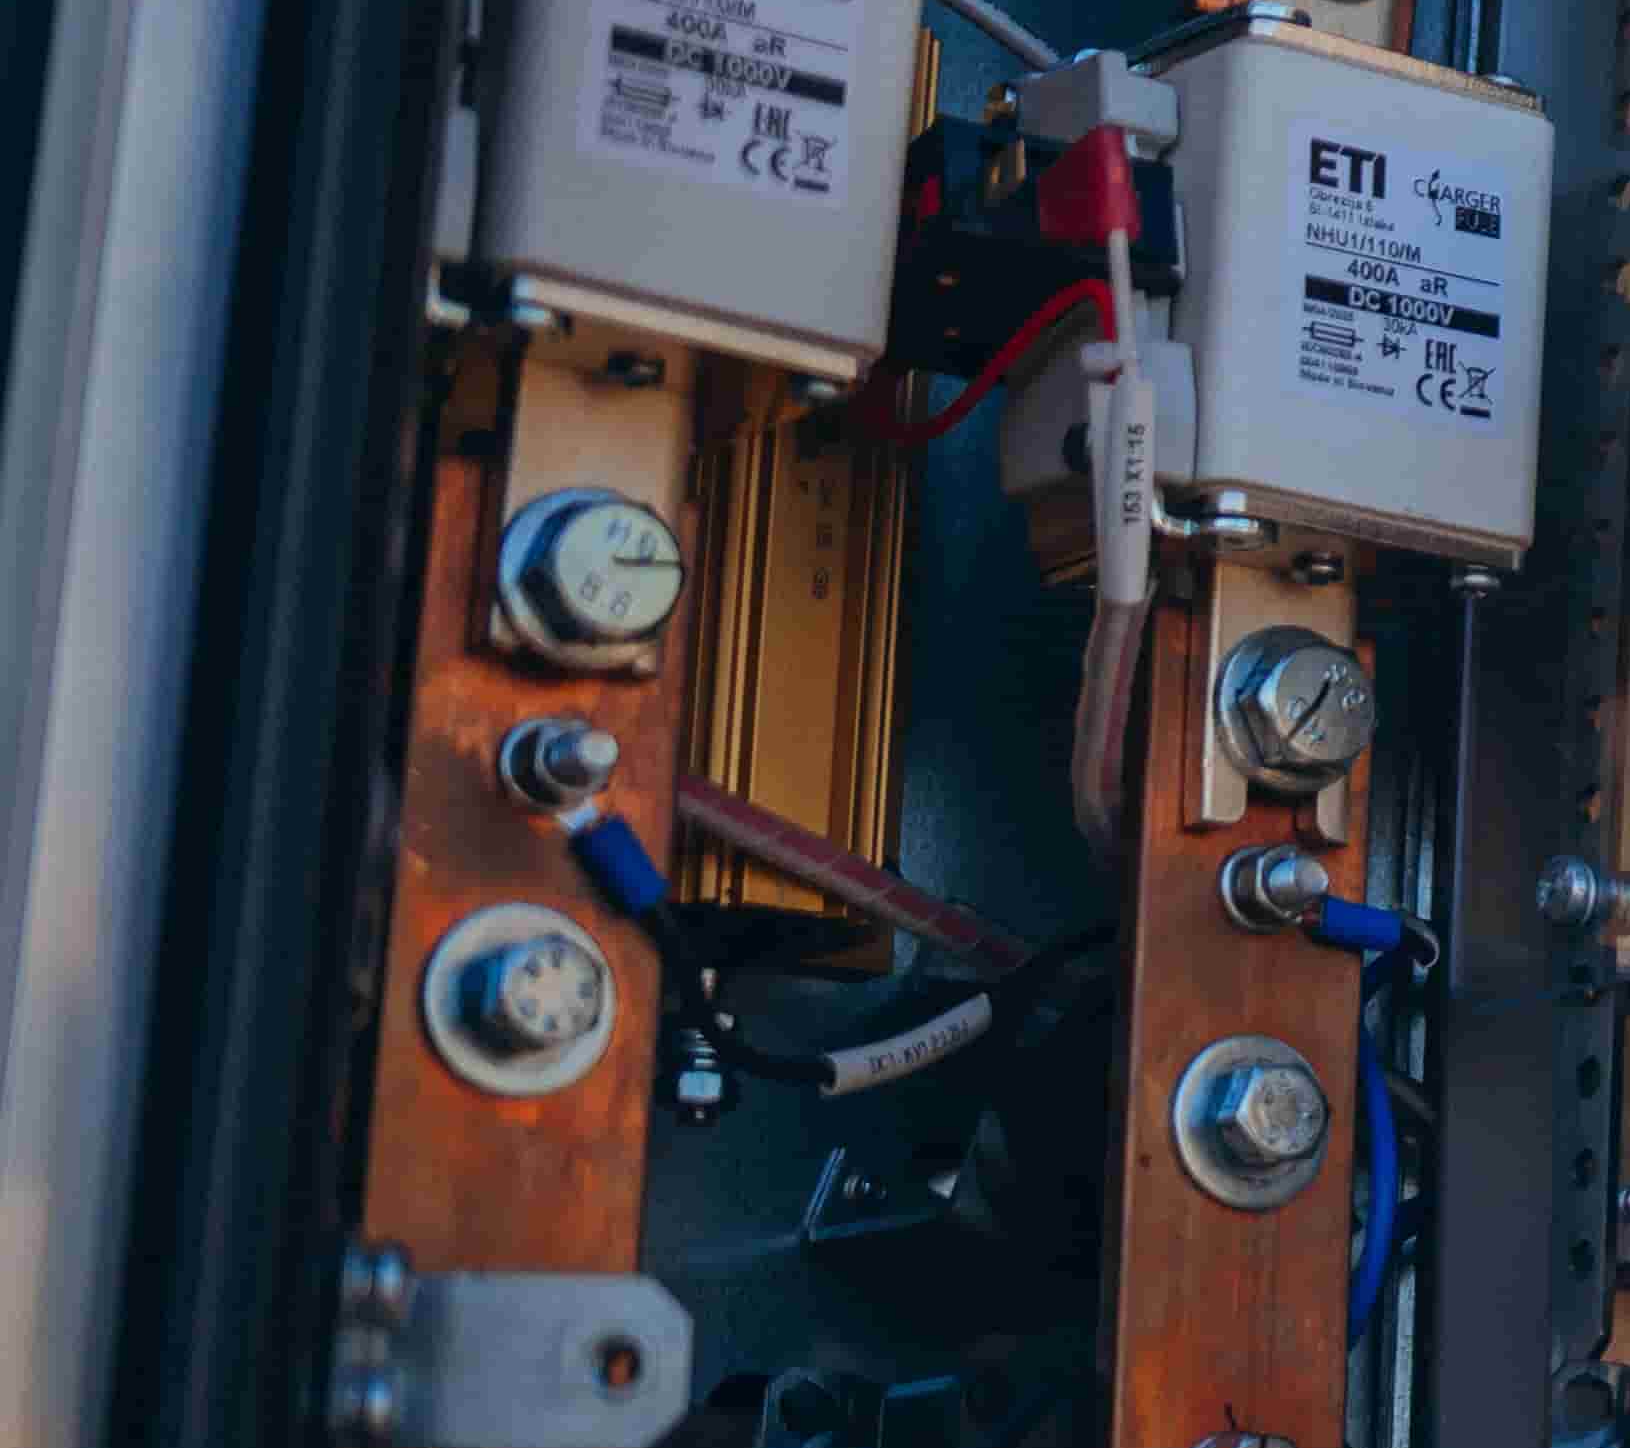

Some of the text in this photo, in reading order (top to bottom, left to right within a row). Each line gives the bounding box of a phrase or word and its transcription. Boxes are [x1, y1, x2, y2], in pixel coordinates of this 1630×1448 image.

[1310, 136, 1386, 199] ETI
[1306, 223, 1421, 264] NHU1/110/M
[1347, 259, 1449, 297] 400A aR
[1349, 285, 1381, 312] DC
[1389, 292, 1455, 325] 1000V
[1415, 373, 1457, 411] CE
